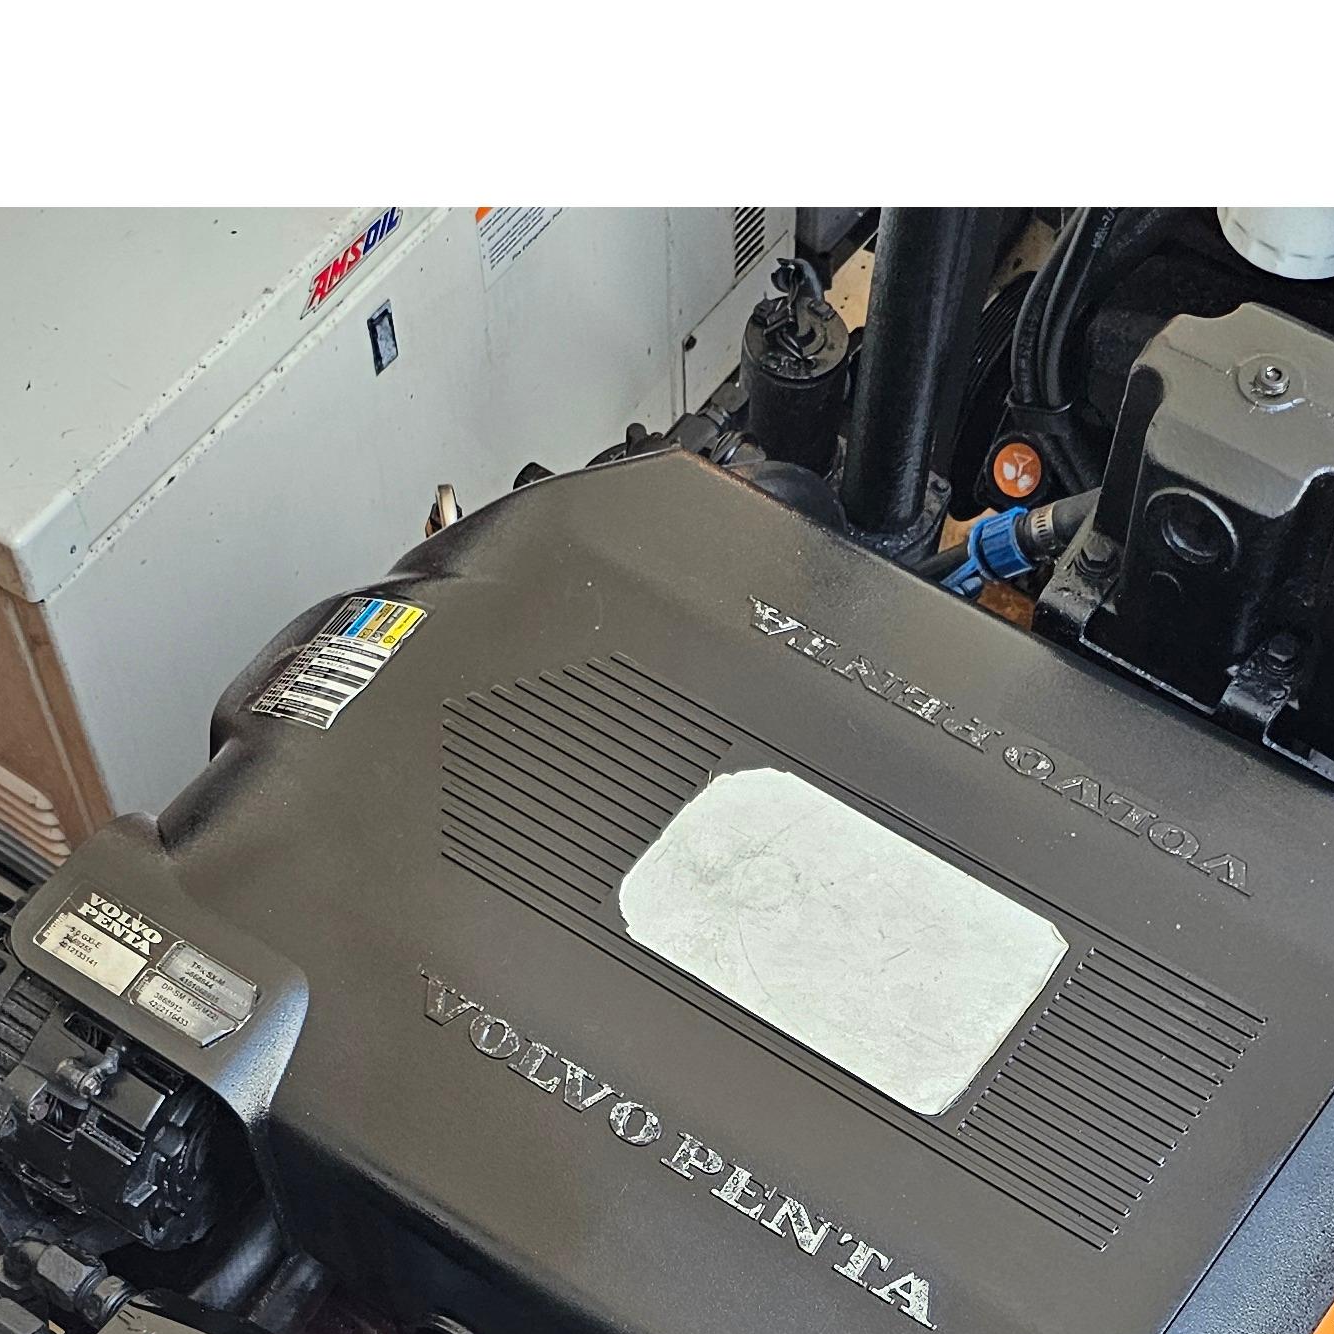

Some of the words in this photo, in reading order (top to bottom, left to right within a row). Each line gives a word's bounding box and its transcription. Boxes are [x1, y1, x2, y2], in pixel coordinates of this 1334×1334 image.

[305, 207, 399, 312] AMSOIL
[747, 596, 1005, 752] PENTA
[1003, 745, 1252, 897] VOLVO
[77, 903, 152, 956] PENTA
[91, 892, 164, 944] VOLVO
[420, 968, 662, 1147] VOLVO
[660, 1133, 937, 1331] PENTA
